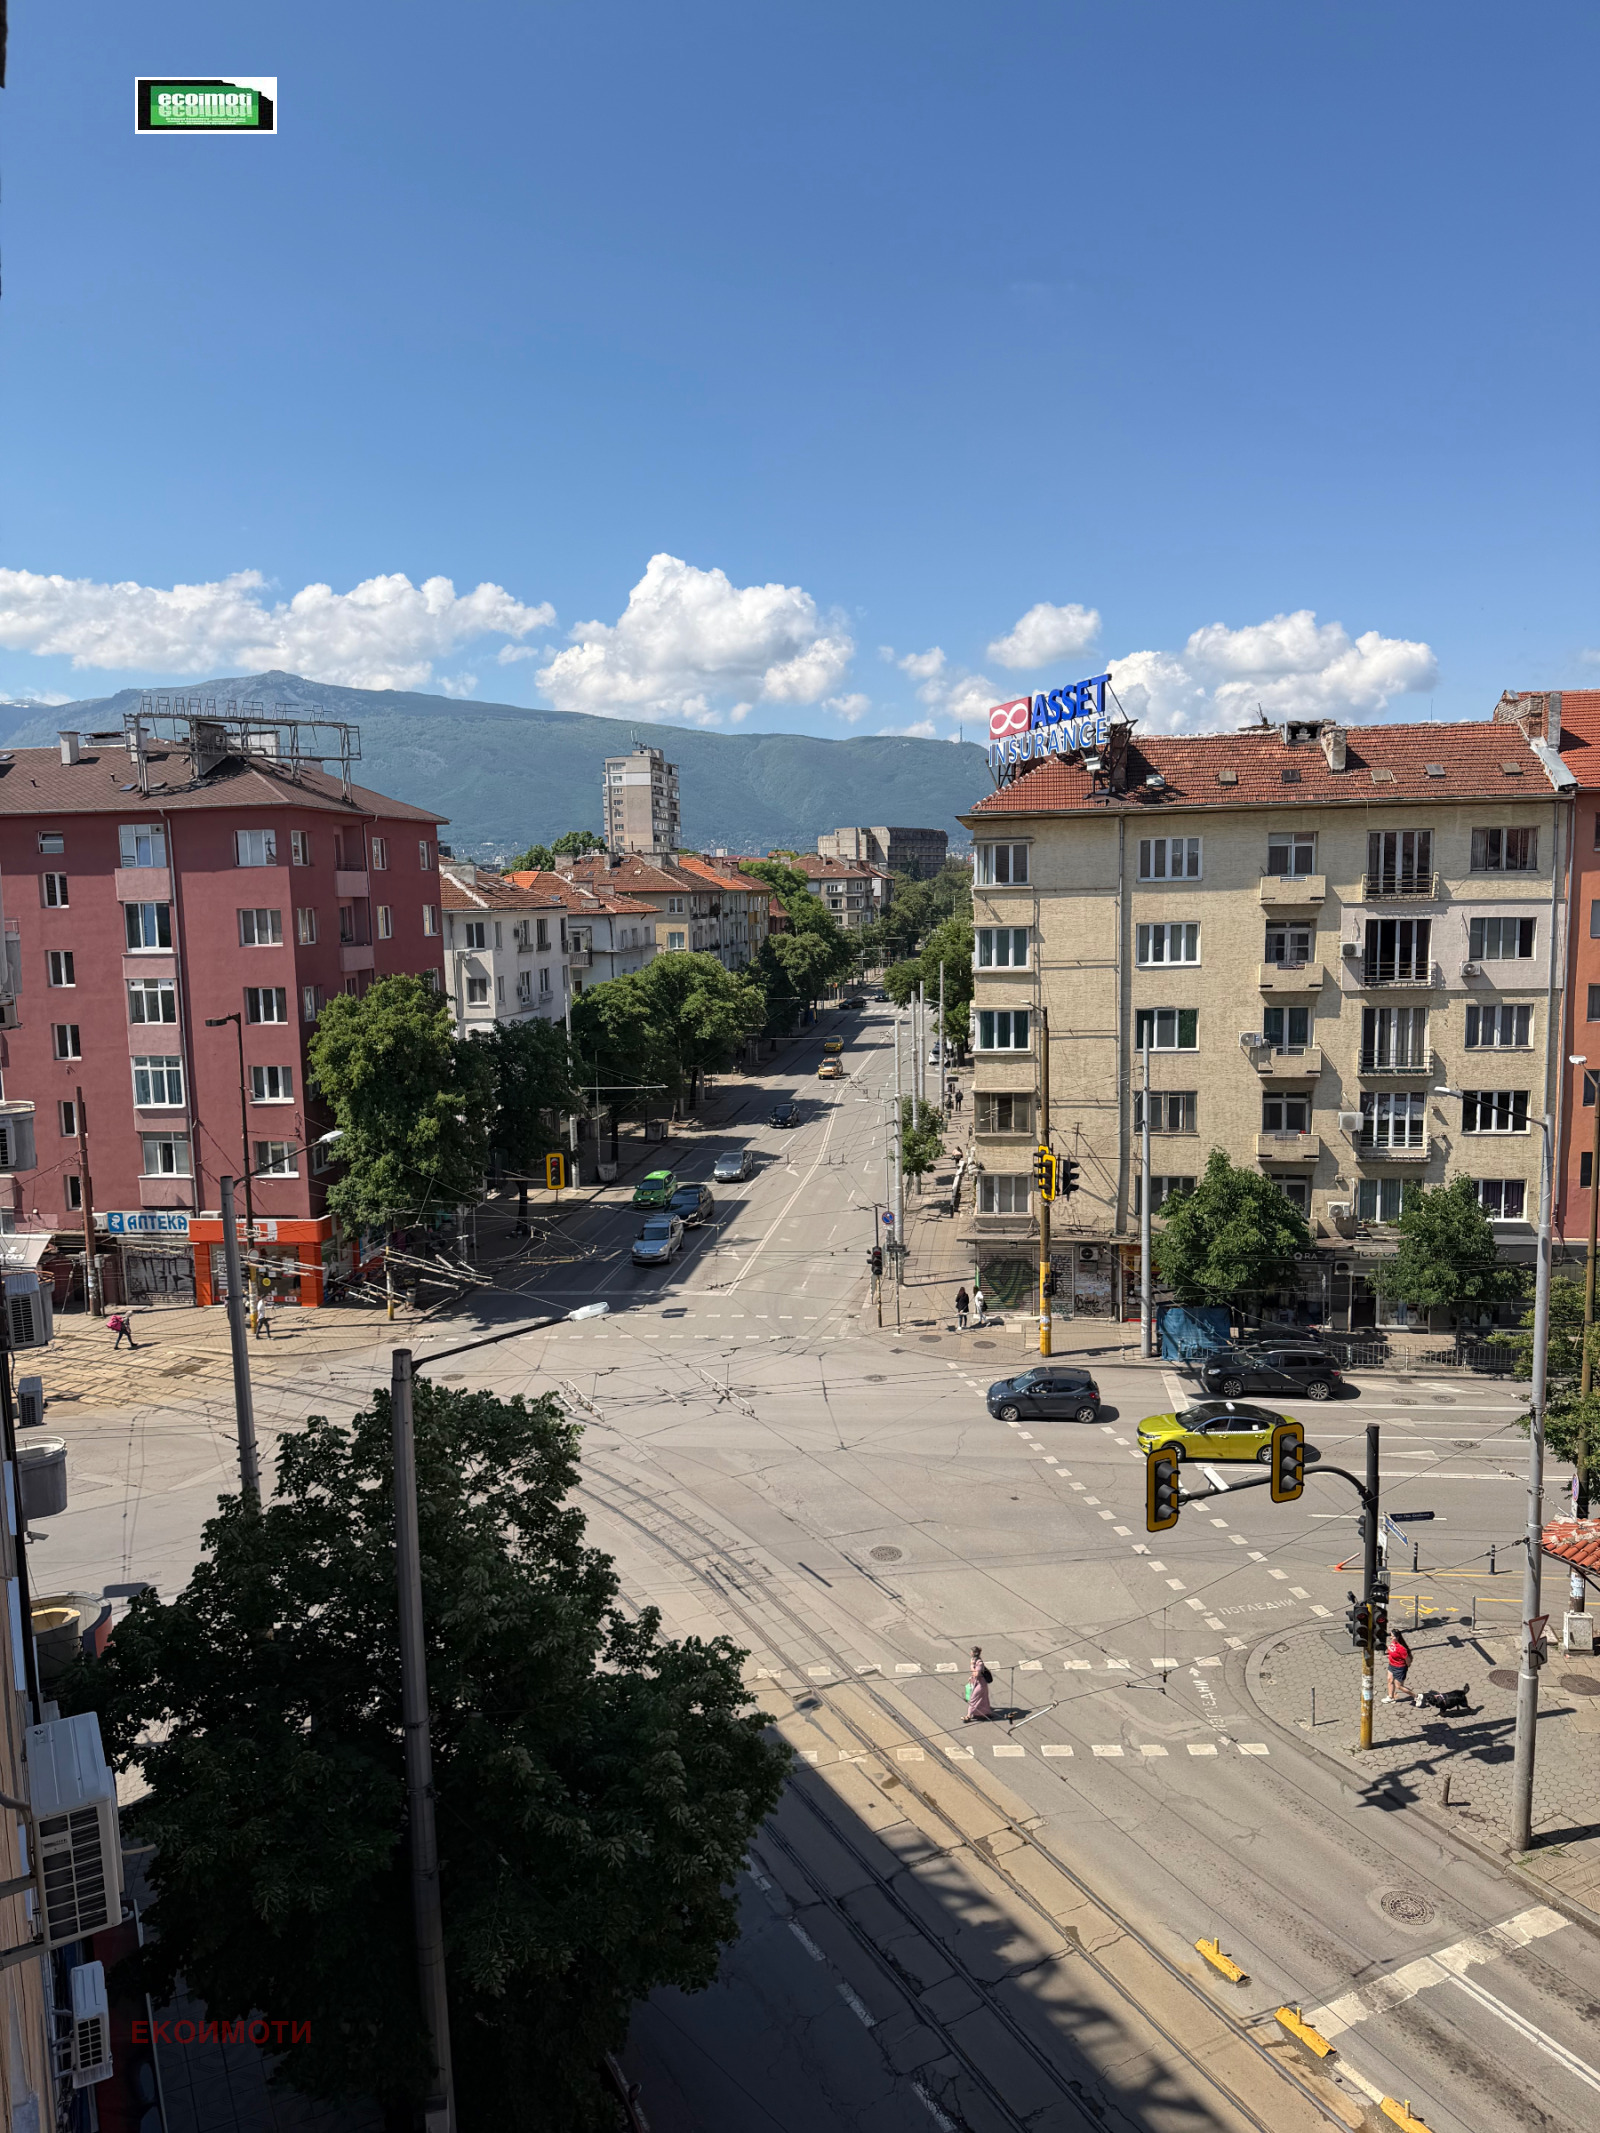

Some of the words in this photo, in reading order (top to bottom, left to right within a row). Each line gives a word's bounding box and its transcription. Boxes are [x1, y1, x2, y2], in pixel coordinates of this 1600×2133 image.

[1031, 673, 1112, 730] ASSET
[988, 716, 1110, 767] INSURANCE
[127, 1214, 188, 1231] АПТЕКА
[1218, 1597, 1297, 1616] ПОГЛЕДНИ
